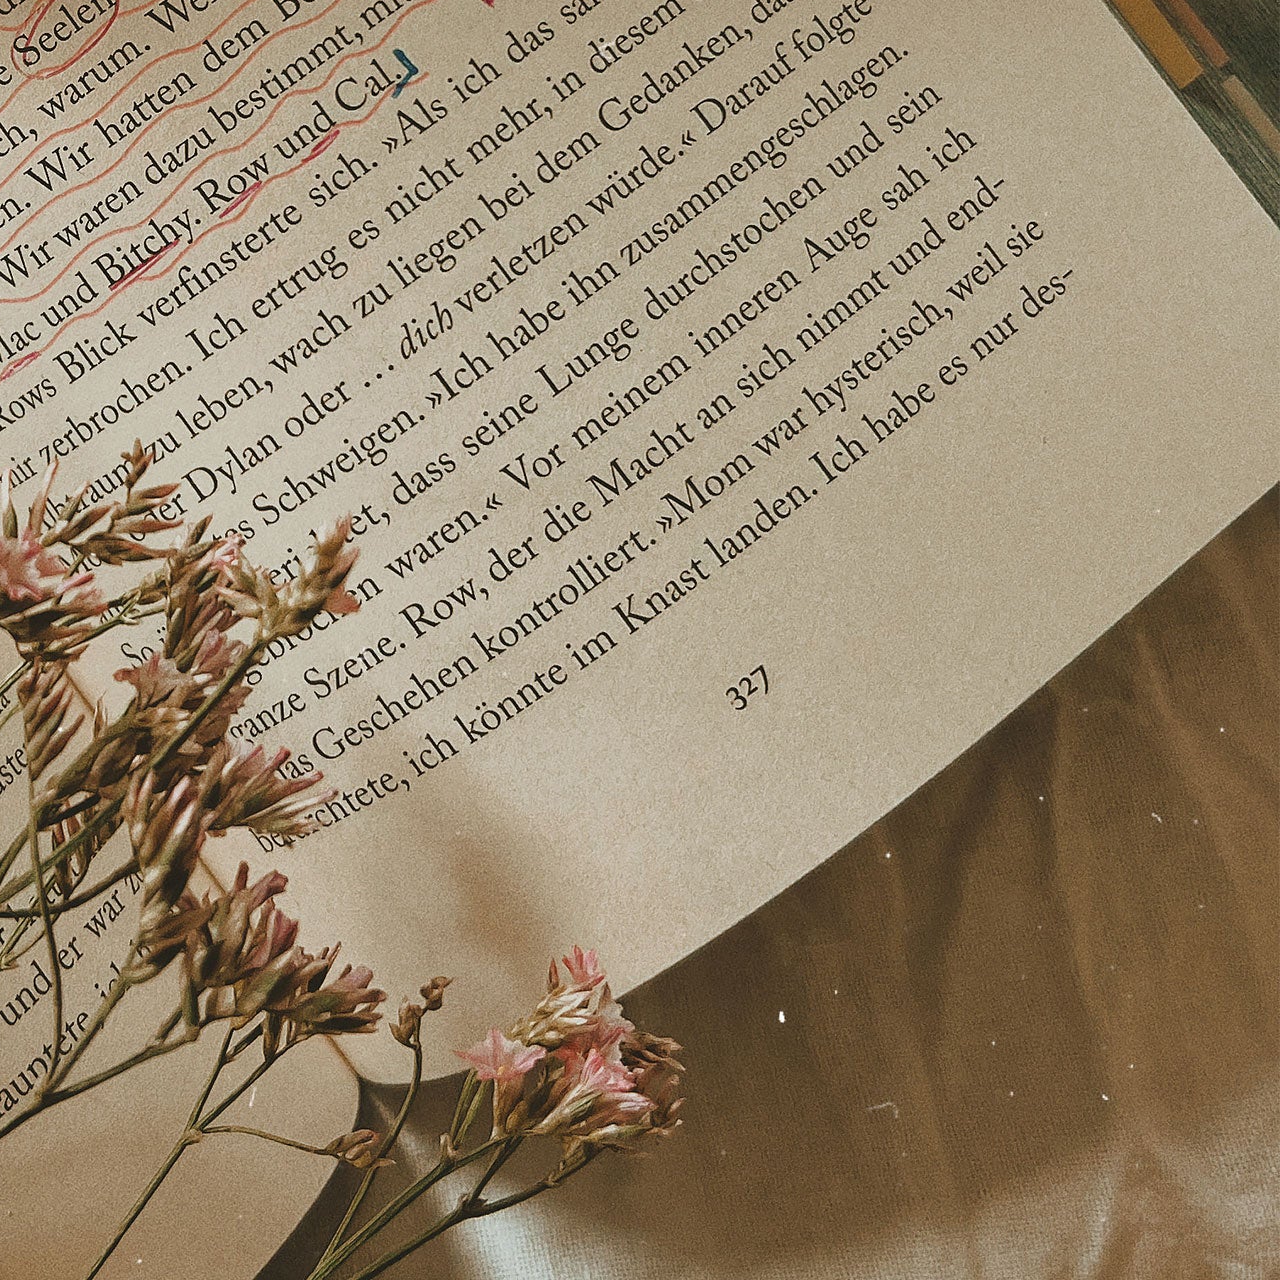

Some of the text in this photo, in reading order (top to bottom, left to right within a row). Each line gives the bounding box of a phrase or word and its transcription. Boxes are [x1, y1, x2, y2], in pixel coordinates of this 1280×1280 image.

[36, 41, 152, 120] warum.
[92, 72, 198, 149] hatten
[51, 319, 138, 385] Blick
[136, 204, 303, 327] verfinsterte
[308, 152, 379, 208] sich.
[380, 97, 449, 155] »Als
[90, 208, 202, 289] Bitchy.
[174, 376, 274, 440] leben,
[386, 217, 487, 290] liegen
[598, 25, 754, 132] Gedanken,
[180, 129, 698, 504] Dylan dich verletzen würde.«
[251, 245, 349, 319] ertrug
[251, 46, 909, 527] Schweigen. zusammengeschlagen.
[534, 177, 828, 399] Lunge durchstochen
[498, 269, 803, 491] Vor meinem inneren
[303, 421, 696, 700] Szene. Row, Macht
[311, 299, 954, 760] Geschehen kontrolliert. »Mom hysterisch,
[452, 269, 1074, 745] könnte Knast landen. des-
[725, 664, 770, 711] 327
